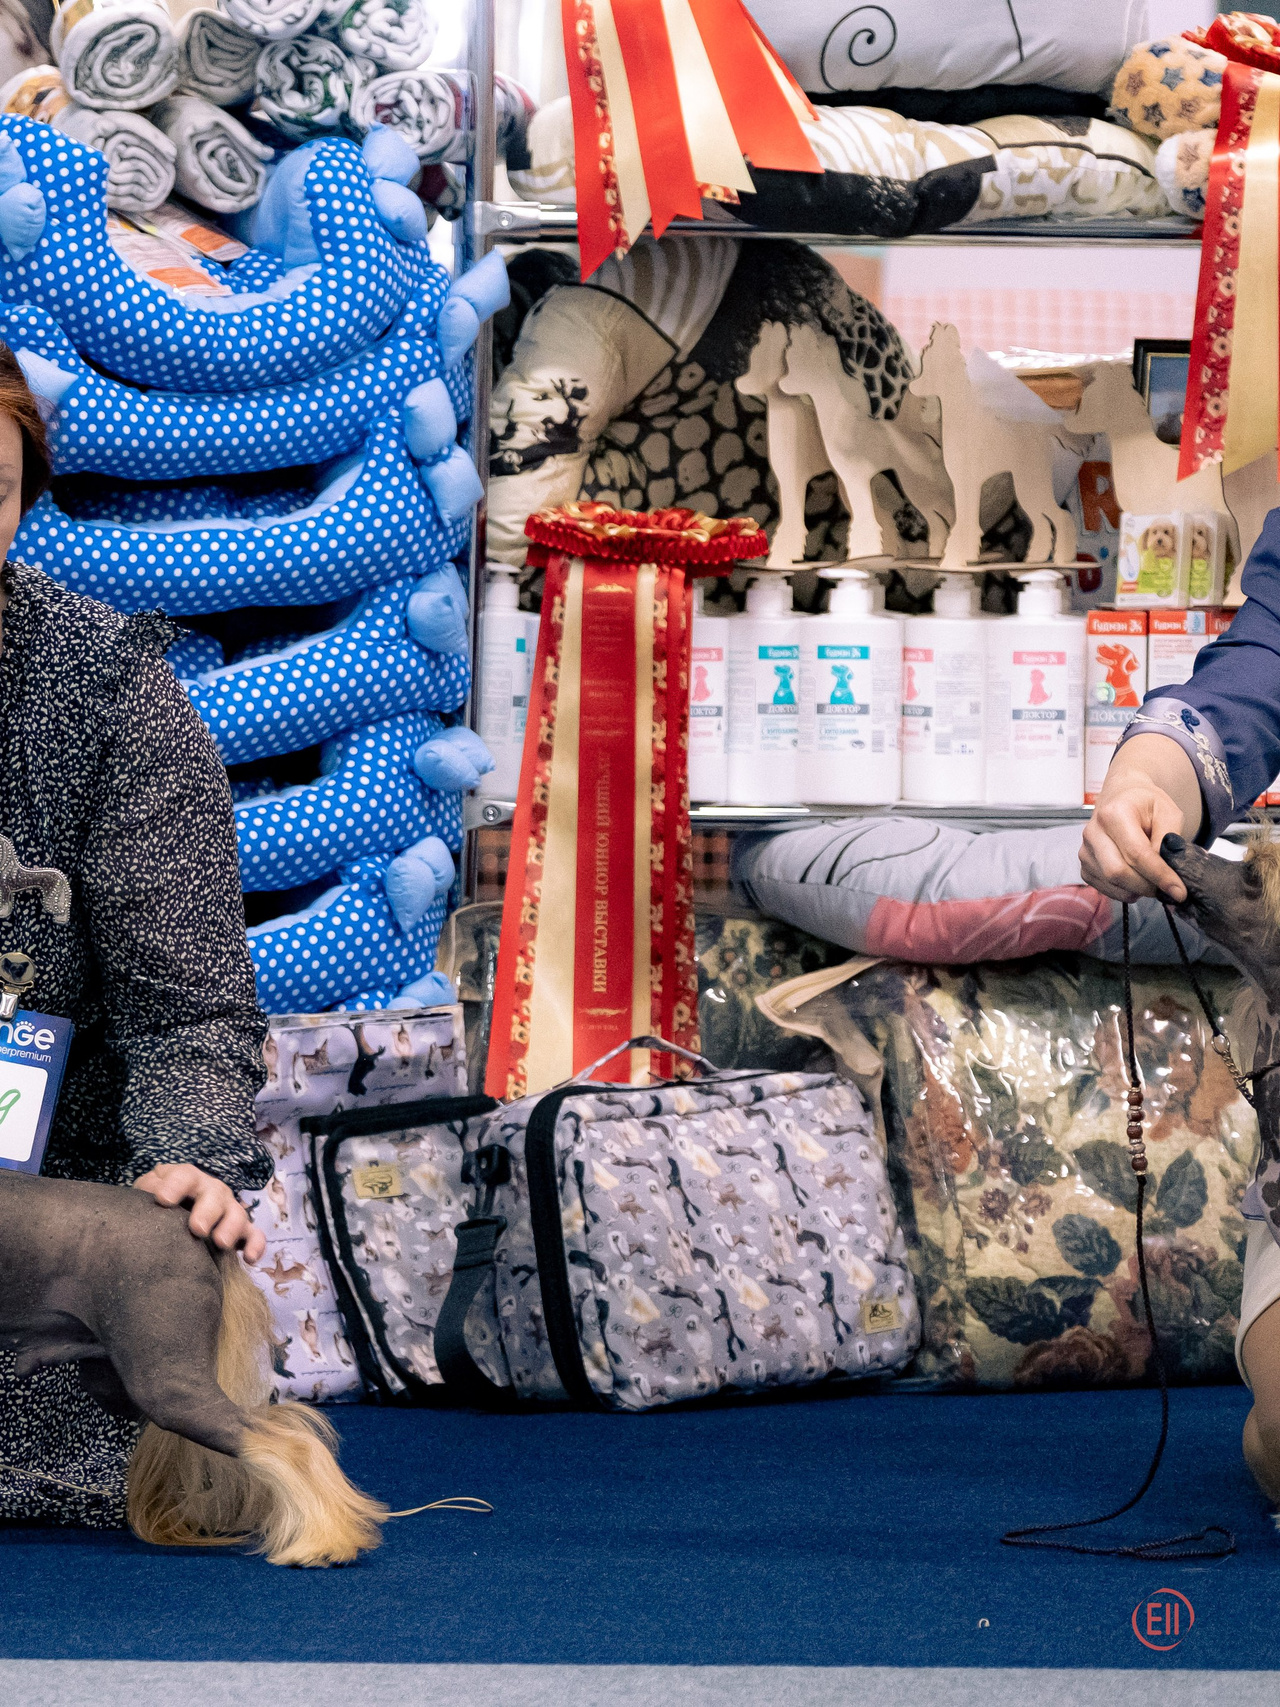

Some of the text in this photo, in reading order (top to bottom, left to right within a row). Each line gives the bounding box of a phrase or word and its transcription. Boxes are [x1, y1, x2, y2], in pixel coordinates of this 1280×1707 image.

[768, 705, 797, 714] ДОКТО
[825, 705, 861, 714] ДОКТОР
[1022, 711, 1058, 719] ДОКТОР
[1089, 709, 1135, 722] ДОКТО
[595, 832, 610, 895] ЮНИОР
[593, 900, 609, 993] ВЫСТАВКИ
